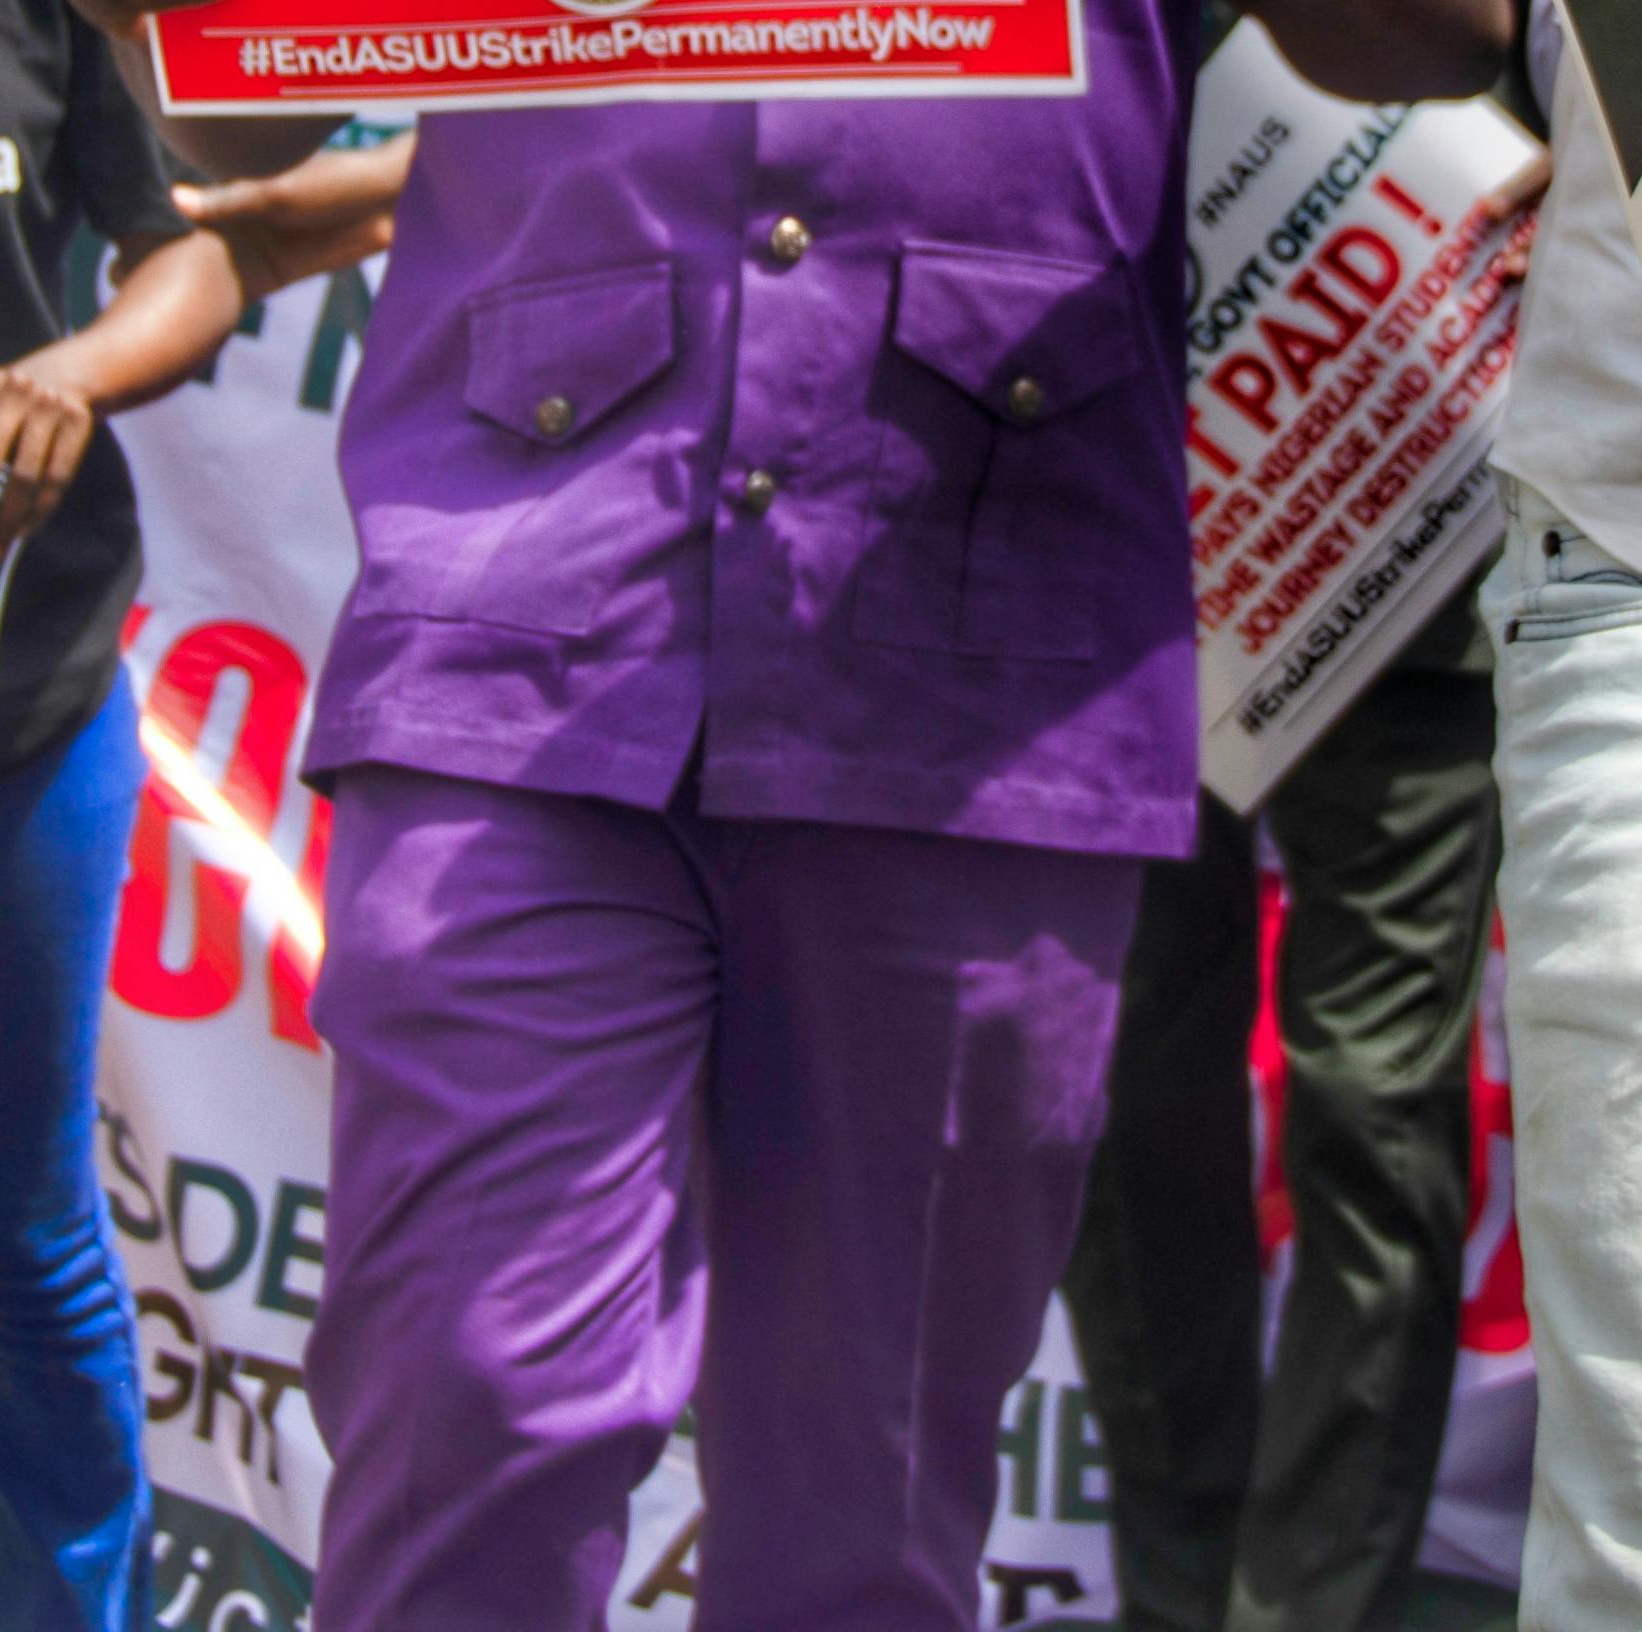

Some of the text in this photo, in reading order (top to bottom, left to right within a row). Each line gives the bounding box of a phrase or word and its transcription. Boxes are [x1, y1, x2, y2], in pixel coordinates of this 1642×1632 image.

[239, 3, 995, 78] #EndASUUStrikePermanentlyNow
[1194, 115, 1291, 228] #NAUS
[1189, 258, 1276, 355] GOVT
[1205, 224, 1402, 437] PAID
[1249, 424, 1379, 566] WASTAGE
[1366, 363, 1432, 441] AND
[1251, 348, 1385, 496] NIGERIAN
[1237, 516, 1357, 656] JOURNEY
